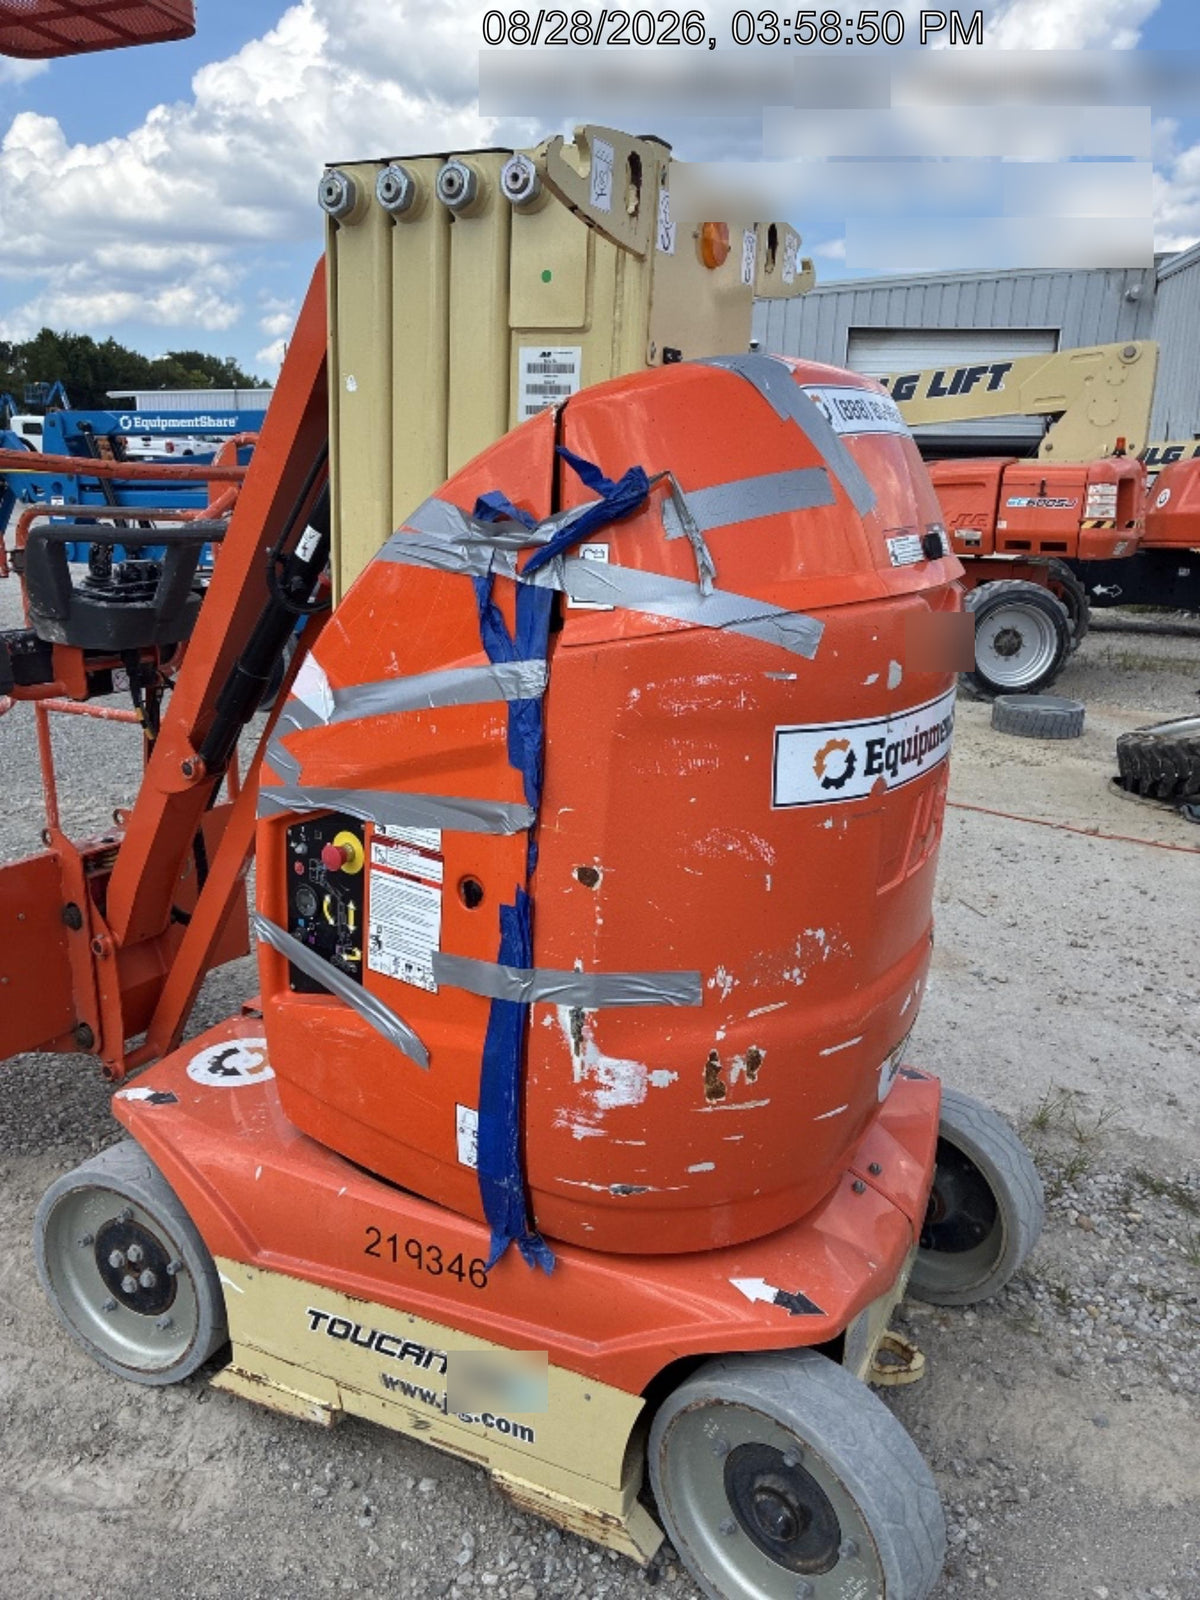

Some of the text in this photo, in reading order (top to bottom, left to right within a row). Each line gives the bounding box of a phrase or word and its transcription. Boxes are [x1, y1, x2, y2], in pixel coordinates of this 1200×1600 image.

[926, 362, 1013, 398] LIFT
[133, 415, 236, 430] EquipmentShare
[364, 1226, 488, 1288] 219346
[307, 1308, 448, 1375] TOUCAN
[381, 1372, 535, 1443] www.j.com
